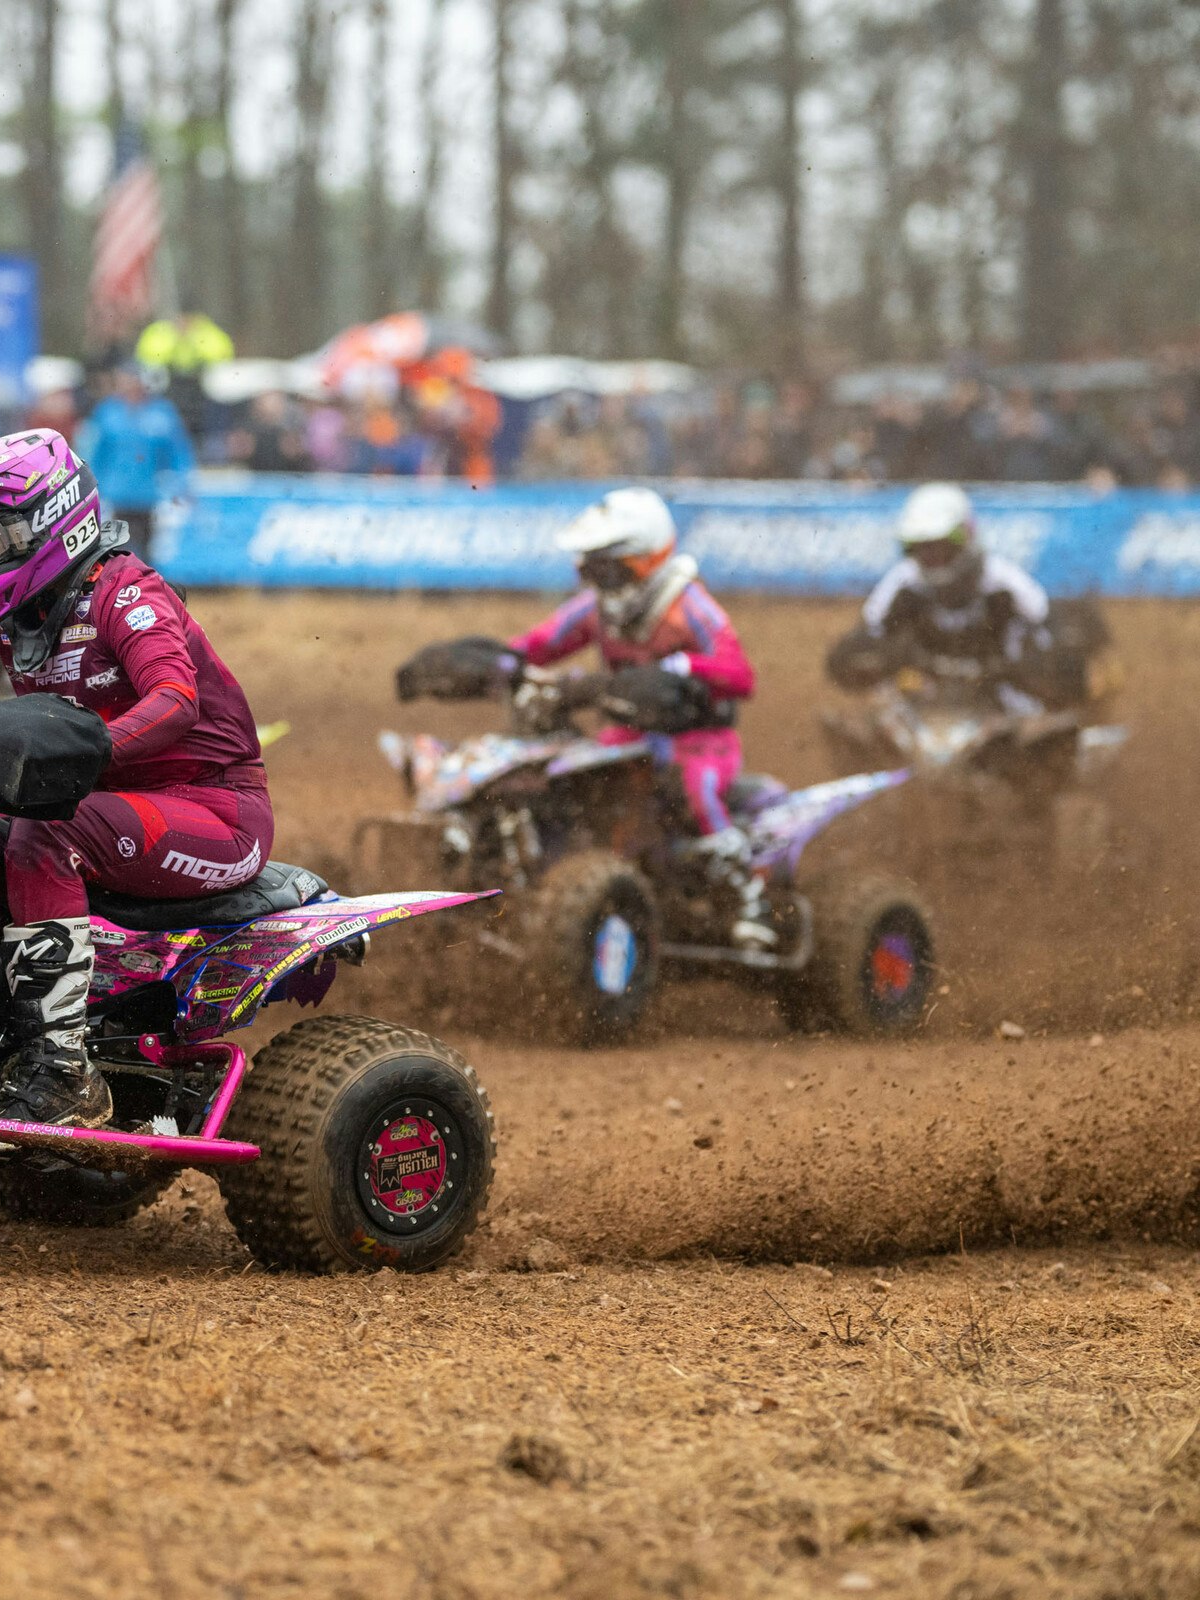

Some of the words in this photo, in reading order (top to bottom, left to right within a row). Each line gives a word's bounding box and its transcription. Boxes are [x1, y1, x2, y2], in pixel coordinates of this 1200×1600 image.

[32, 475, 81, 533] LEATT
[65, 516, 97, 554] 923
[36, 669, 81, 687] RACING
[85, 667, 120, 690] PGX
[161, 838, 261, 881] MOOSE
[90, 928, 126, 941] XIS
[316, 917, 368, 944] QuadTech
[23, 1122, 74, 1137] RACING
